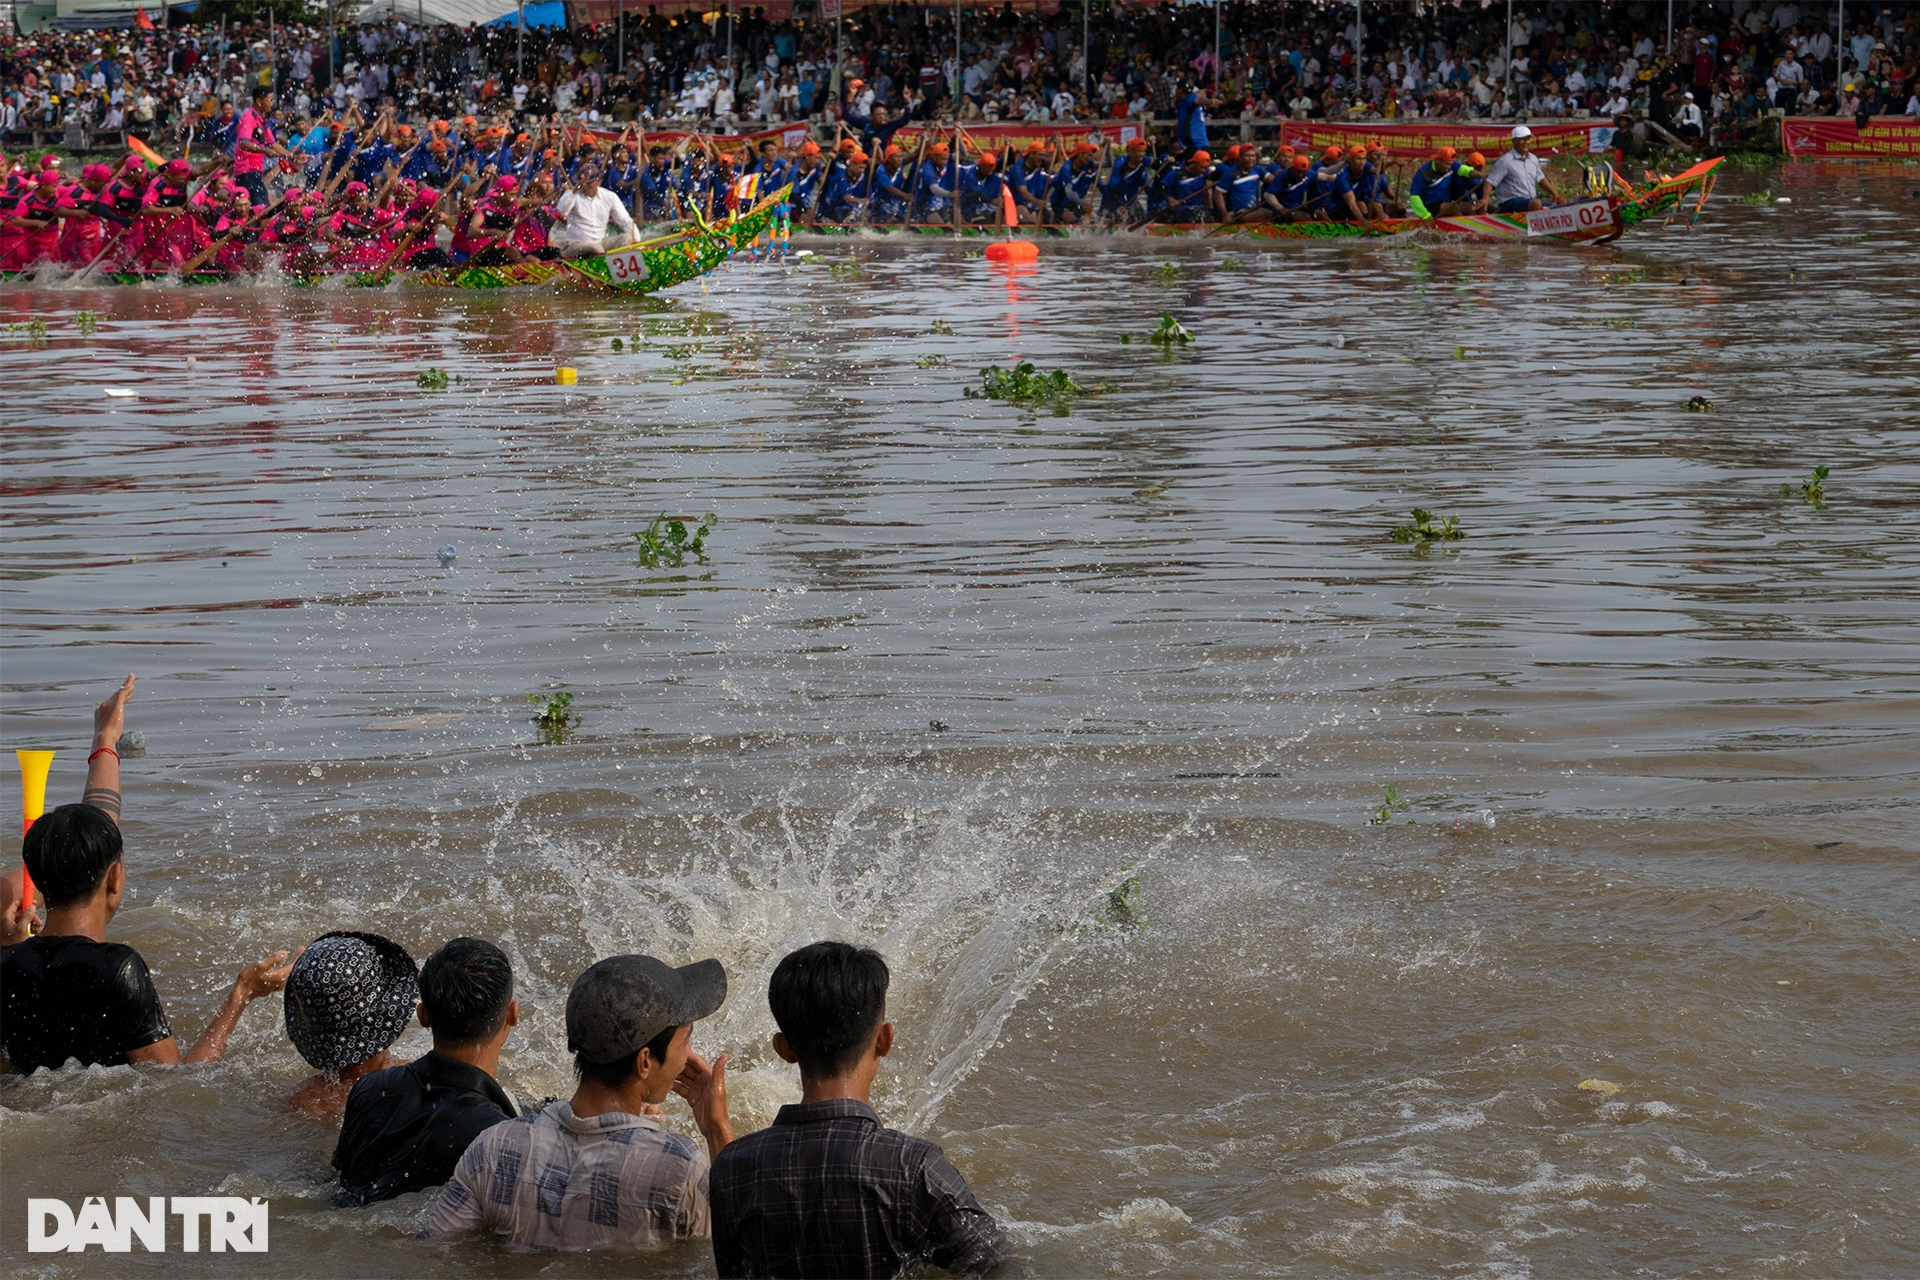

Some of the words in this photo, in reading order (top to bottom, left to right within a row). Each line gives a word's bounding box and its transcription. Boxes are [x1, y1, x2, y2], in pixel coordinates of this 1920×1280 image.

[1891, 125, 1903, 138] VÀ
[1579, 205, 1607, 225] 02
[613, 255, 641, 278] 34
